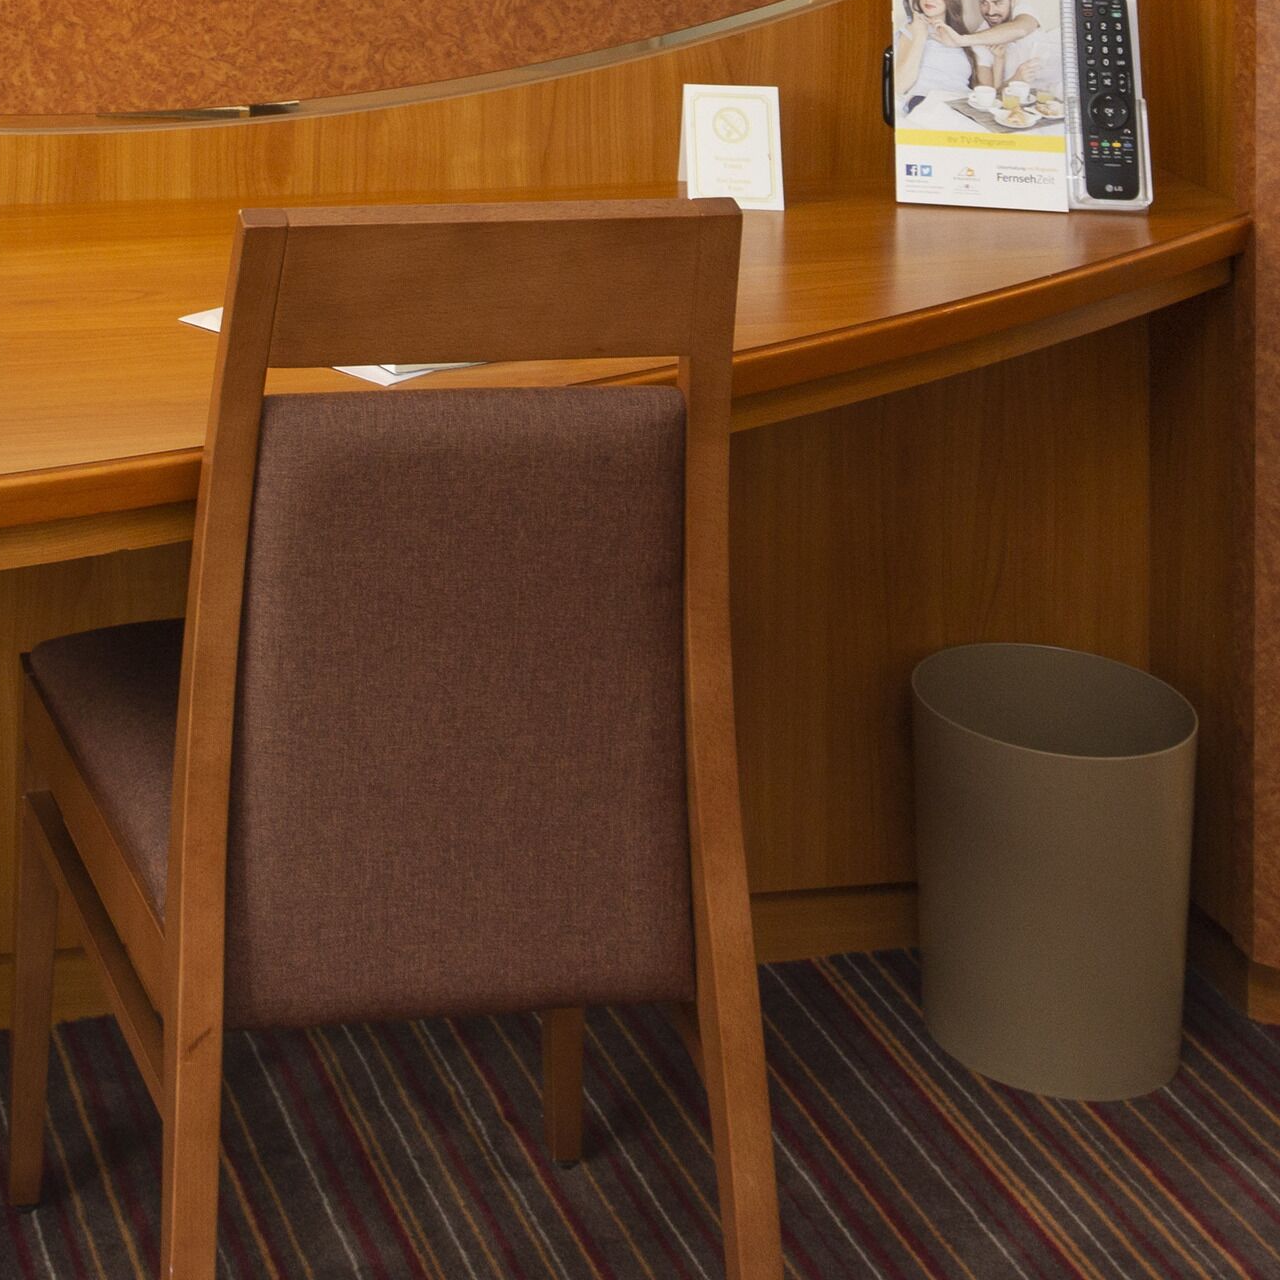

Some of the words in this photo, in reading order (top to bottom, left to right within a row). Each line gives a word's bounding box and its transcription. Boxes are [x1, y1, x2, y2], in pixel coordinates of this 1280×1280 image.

[1100, 22, 1107, 30] 2
[1115, 22, 1122, 30] 3
[1101, 35, 1108, 43] 5
[1116, 35, 1123, 43] 6
[1087, 46, 1093, 54] 7
[1102, 46, 1109, 54] 8
[1102, 58, 1110, 66] 0
[996, 172, 1055, 185] FernsehZeit
